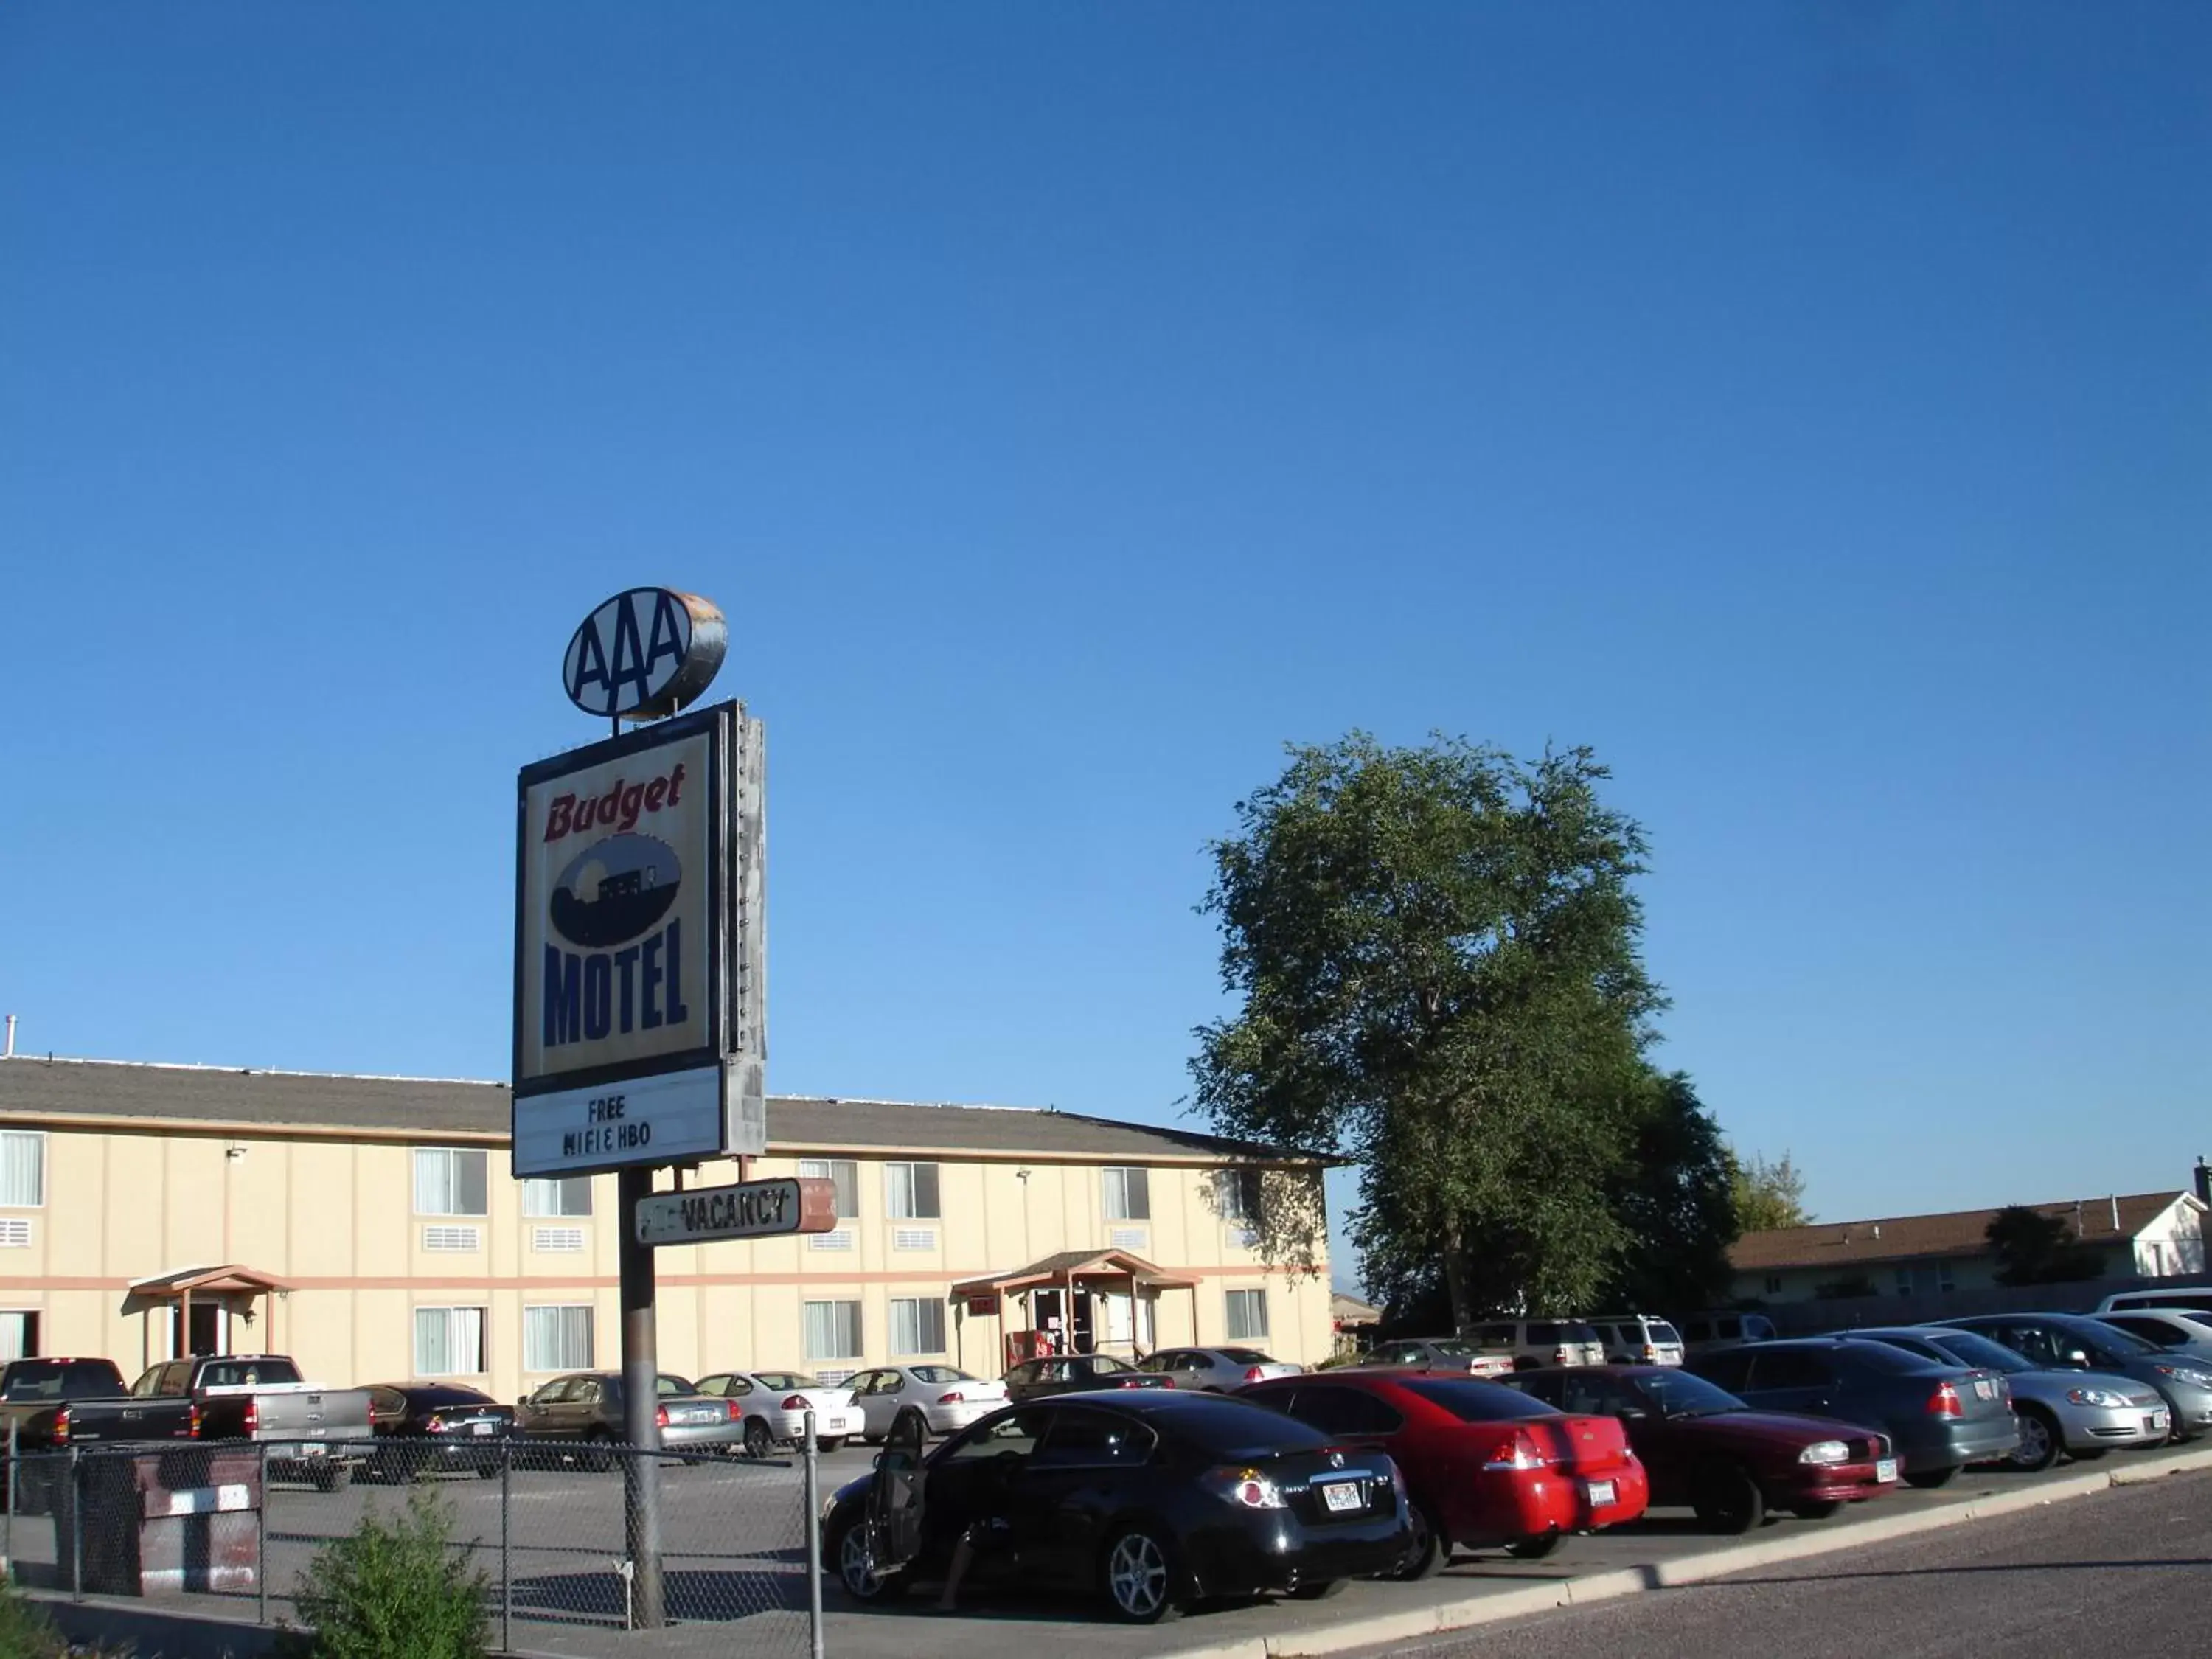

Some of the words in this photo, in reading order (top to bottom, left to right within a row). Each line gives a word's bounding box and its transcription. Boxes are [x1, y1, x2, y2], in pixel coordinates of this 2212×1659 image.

[566, 588, 690, 715] AAA
[544, 762, 685, 843] Budget
[544, 917, 687, 1047] MOTEL
[588, 1096, 625, 1122] FREE
[618, 1121, 650, 1149] HBO
[682, 1188, 789, 1231] VACANCY
